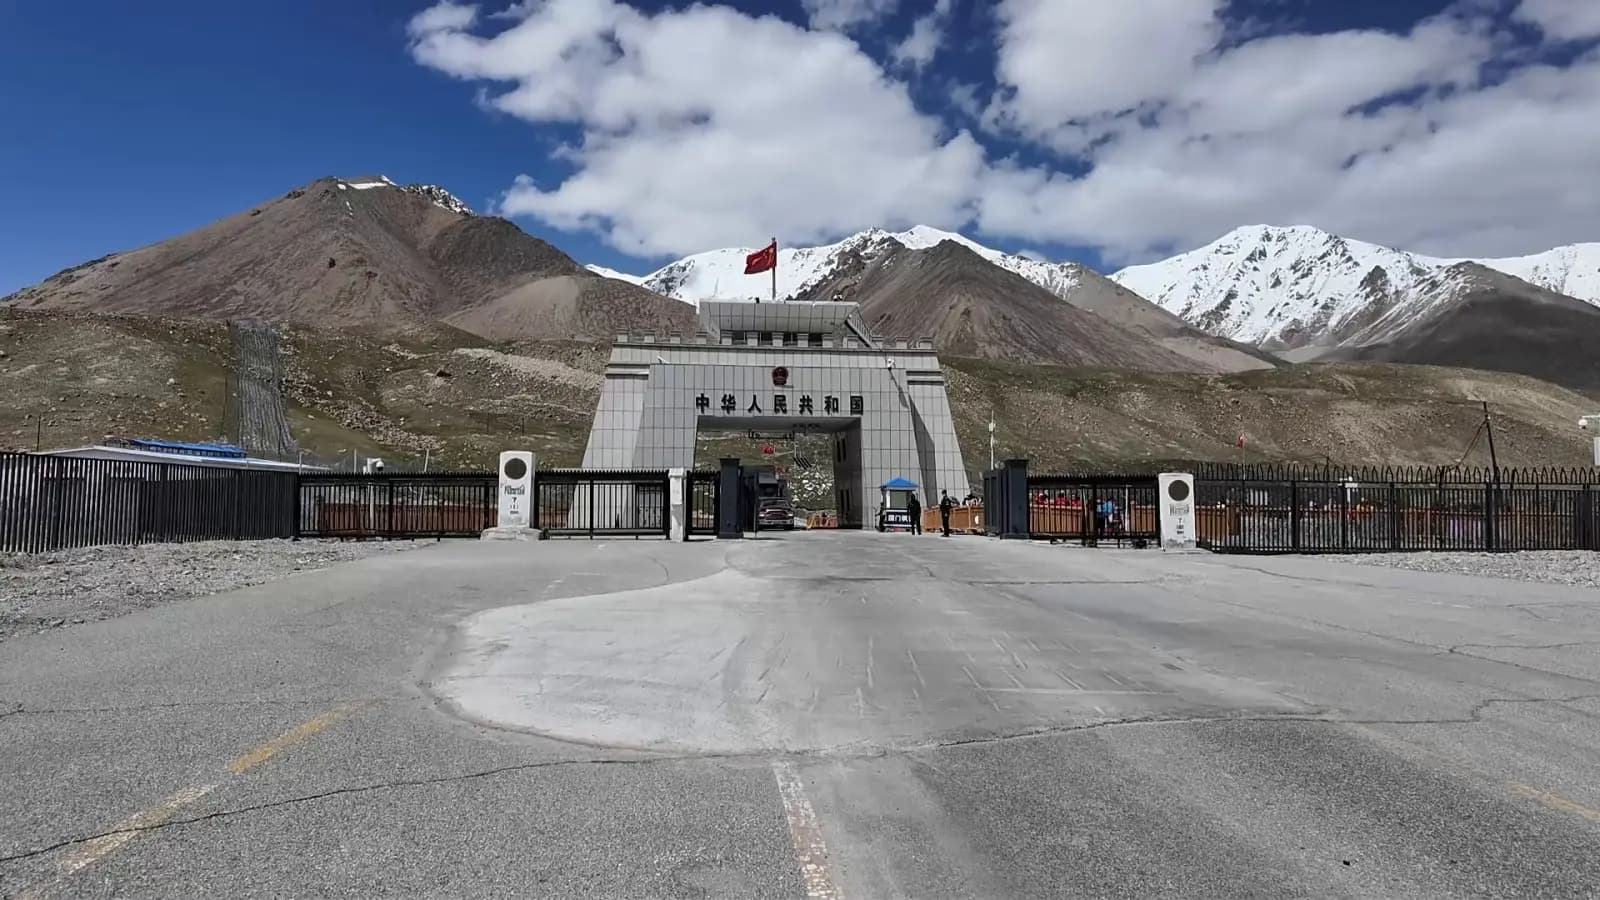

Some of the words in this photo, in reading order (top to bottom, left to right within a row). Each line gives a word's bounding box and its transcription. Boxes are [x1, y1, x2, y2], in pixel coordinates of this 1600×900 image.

[695, 393, 864, 416] 中华人民共和国
